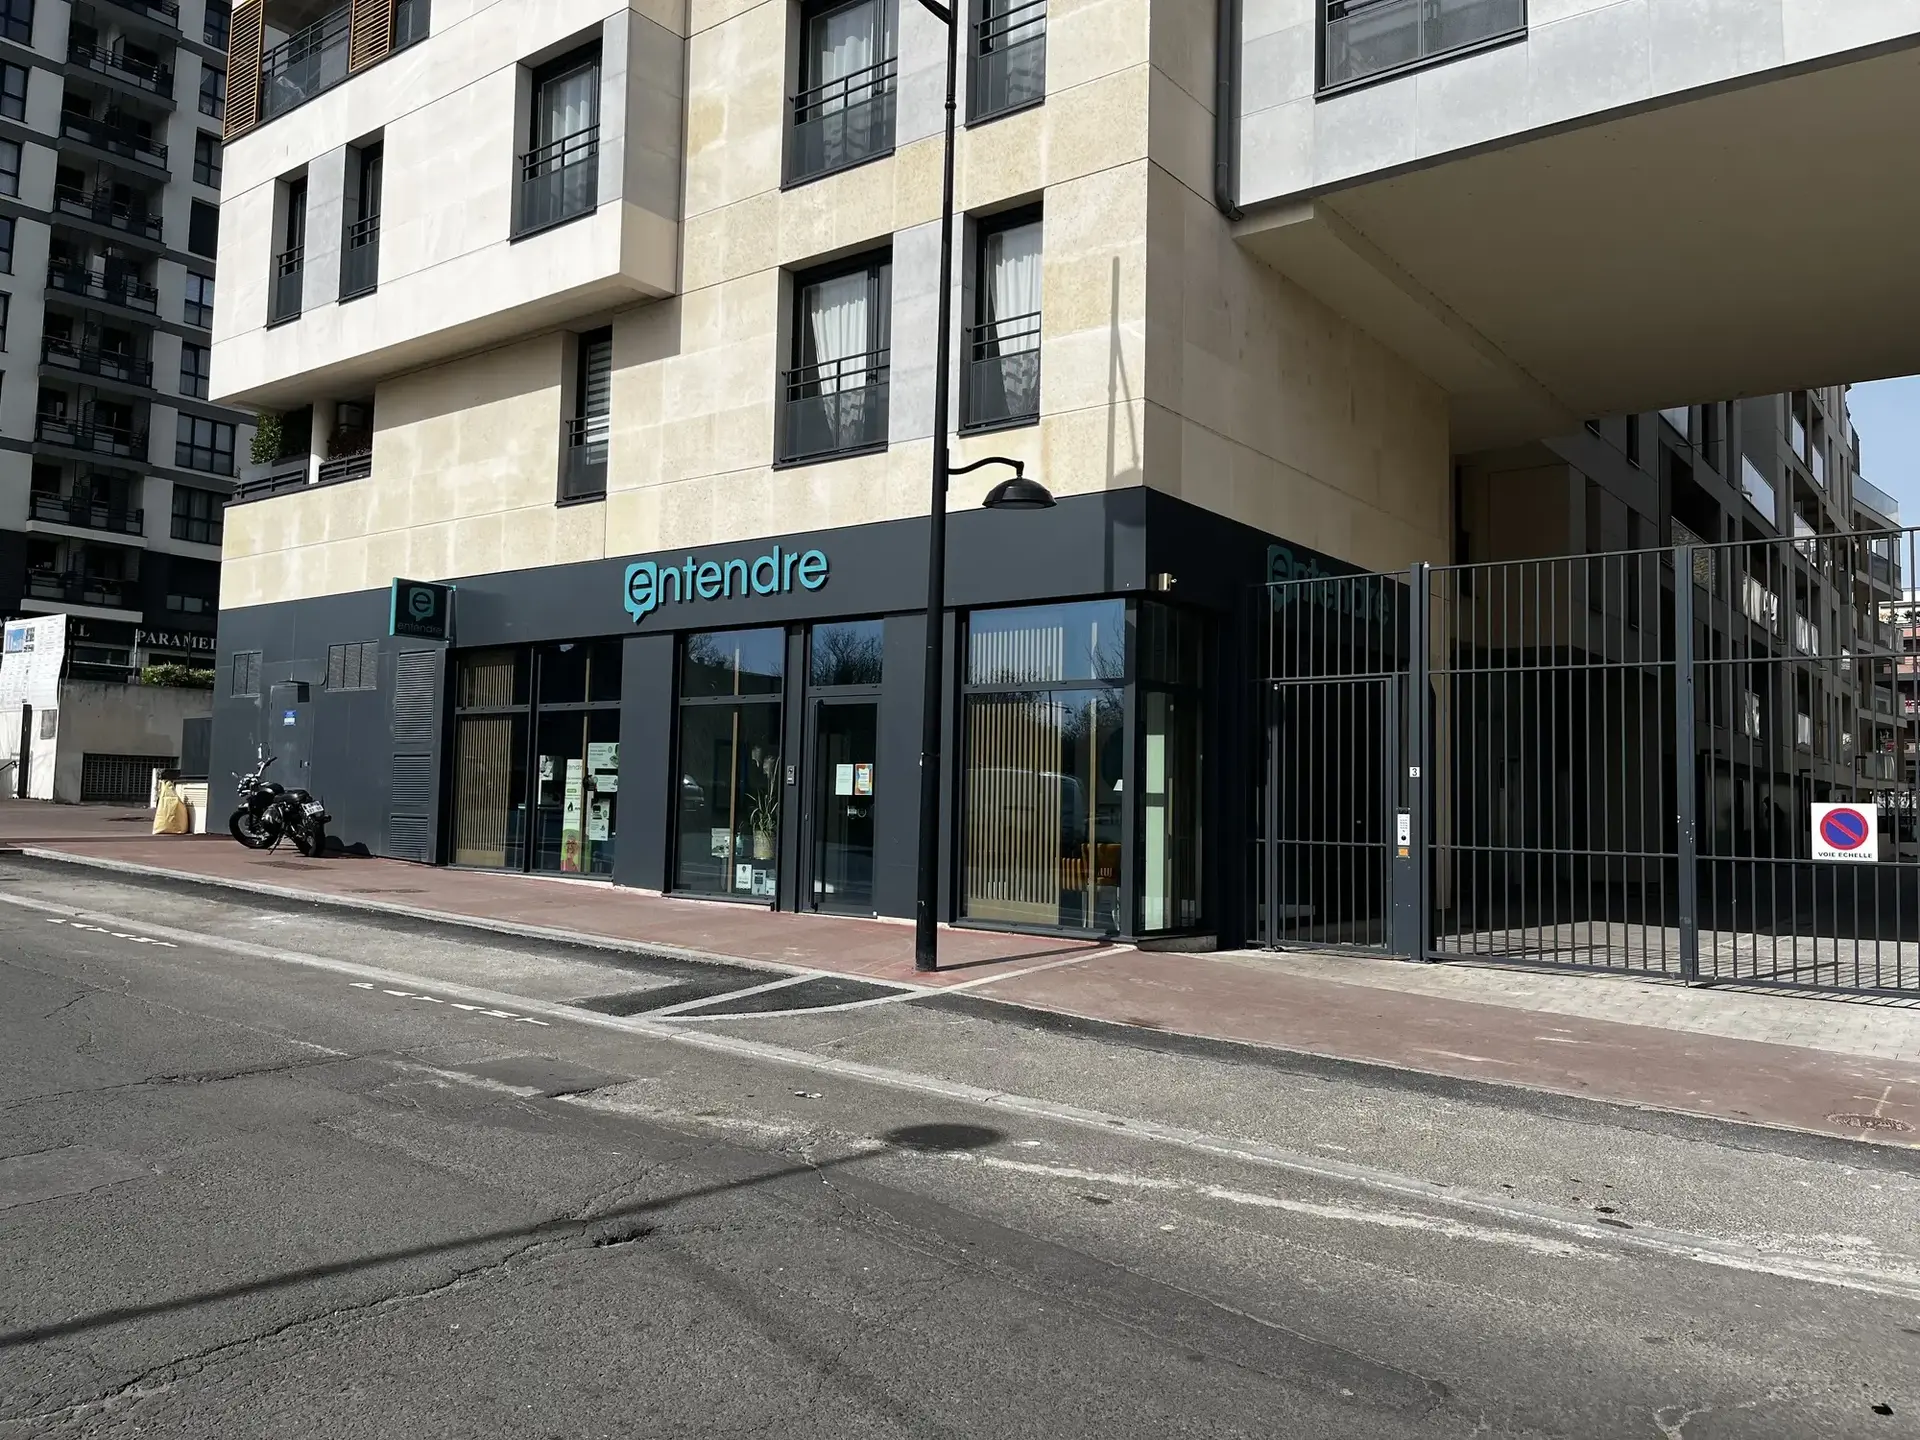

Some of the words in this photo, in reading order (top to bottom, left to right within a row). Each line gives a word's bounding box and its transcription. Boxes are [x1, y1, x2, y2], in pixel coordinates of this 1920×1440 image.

[624, 545, 828, 622] entendre
[1267, 544, 1390, 626] entendre
[397, 622, 443, 633] entendre
